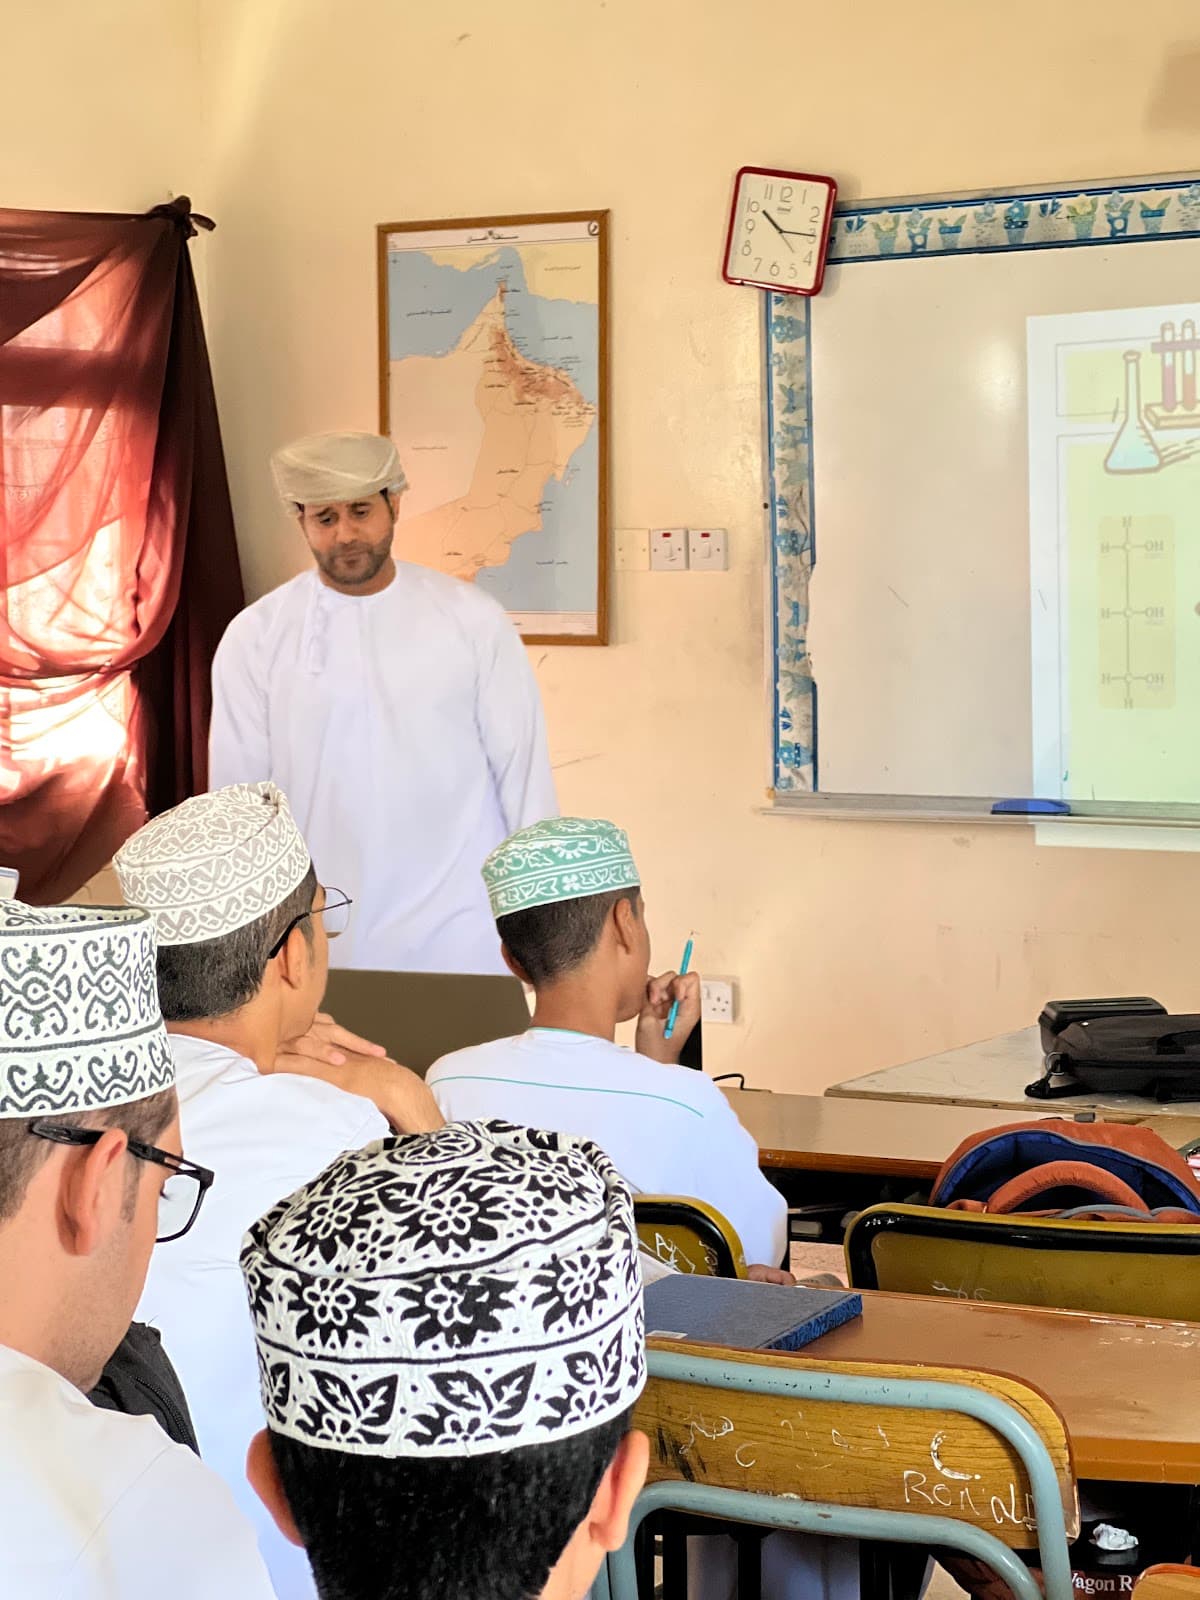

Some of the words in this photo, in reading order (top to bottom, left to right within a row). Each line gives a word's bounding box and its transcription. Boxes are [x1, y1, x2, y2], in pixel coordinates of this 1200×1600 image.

[763, 183, 774, 201] 11
[780, 186, 793, 203] 12
[746, 197, 760, 213] 10
[809, 206, 820, 224] 2
[745, 218, 756, 234] 9
[807, 227, 817, 245] 3
[741, 240, 752, 256] 8
[803, 250, 813, 266] 4
[753, 257, 763, 273] 7
[769, 261, 780, 277] 6
[787, 263, 798, 279] 5
[1119, 1575, 1133, 1591] R
